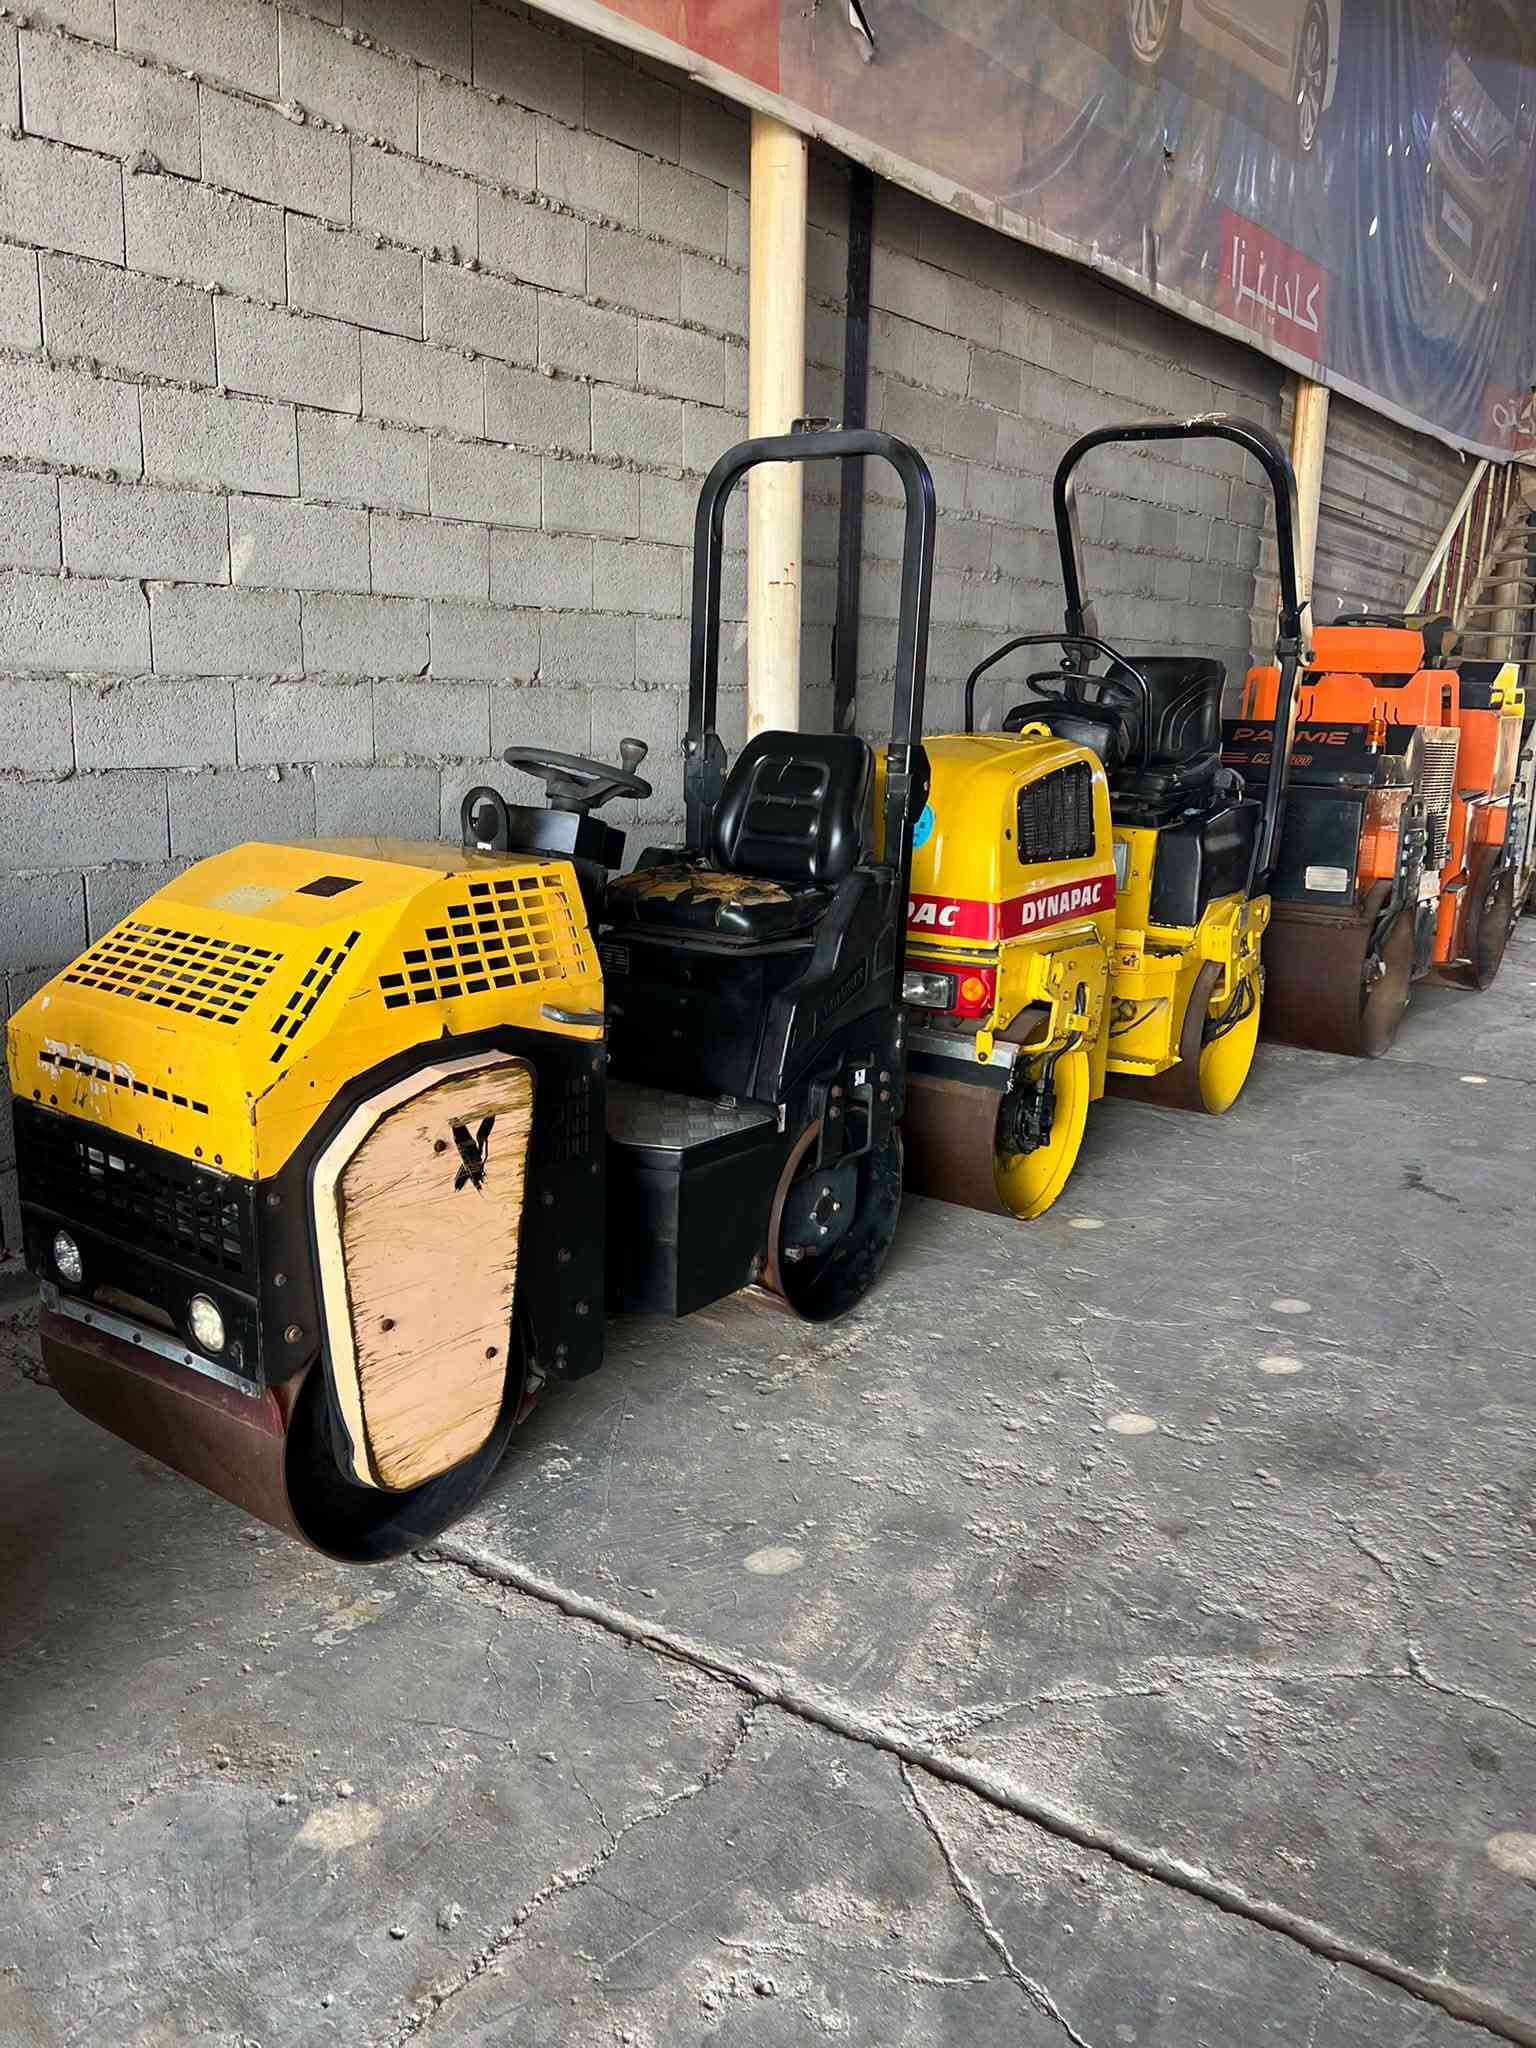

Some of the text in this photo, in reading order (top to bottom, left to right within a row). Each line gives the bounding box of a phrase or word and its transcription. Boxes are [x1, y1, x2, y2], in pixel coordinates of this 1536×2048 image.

[1232, 236, 1320, 332] كادينزا
[1232, 727, 1350, 745] PAME
[1021, 883, 1102, 926] DYNAPAC
